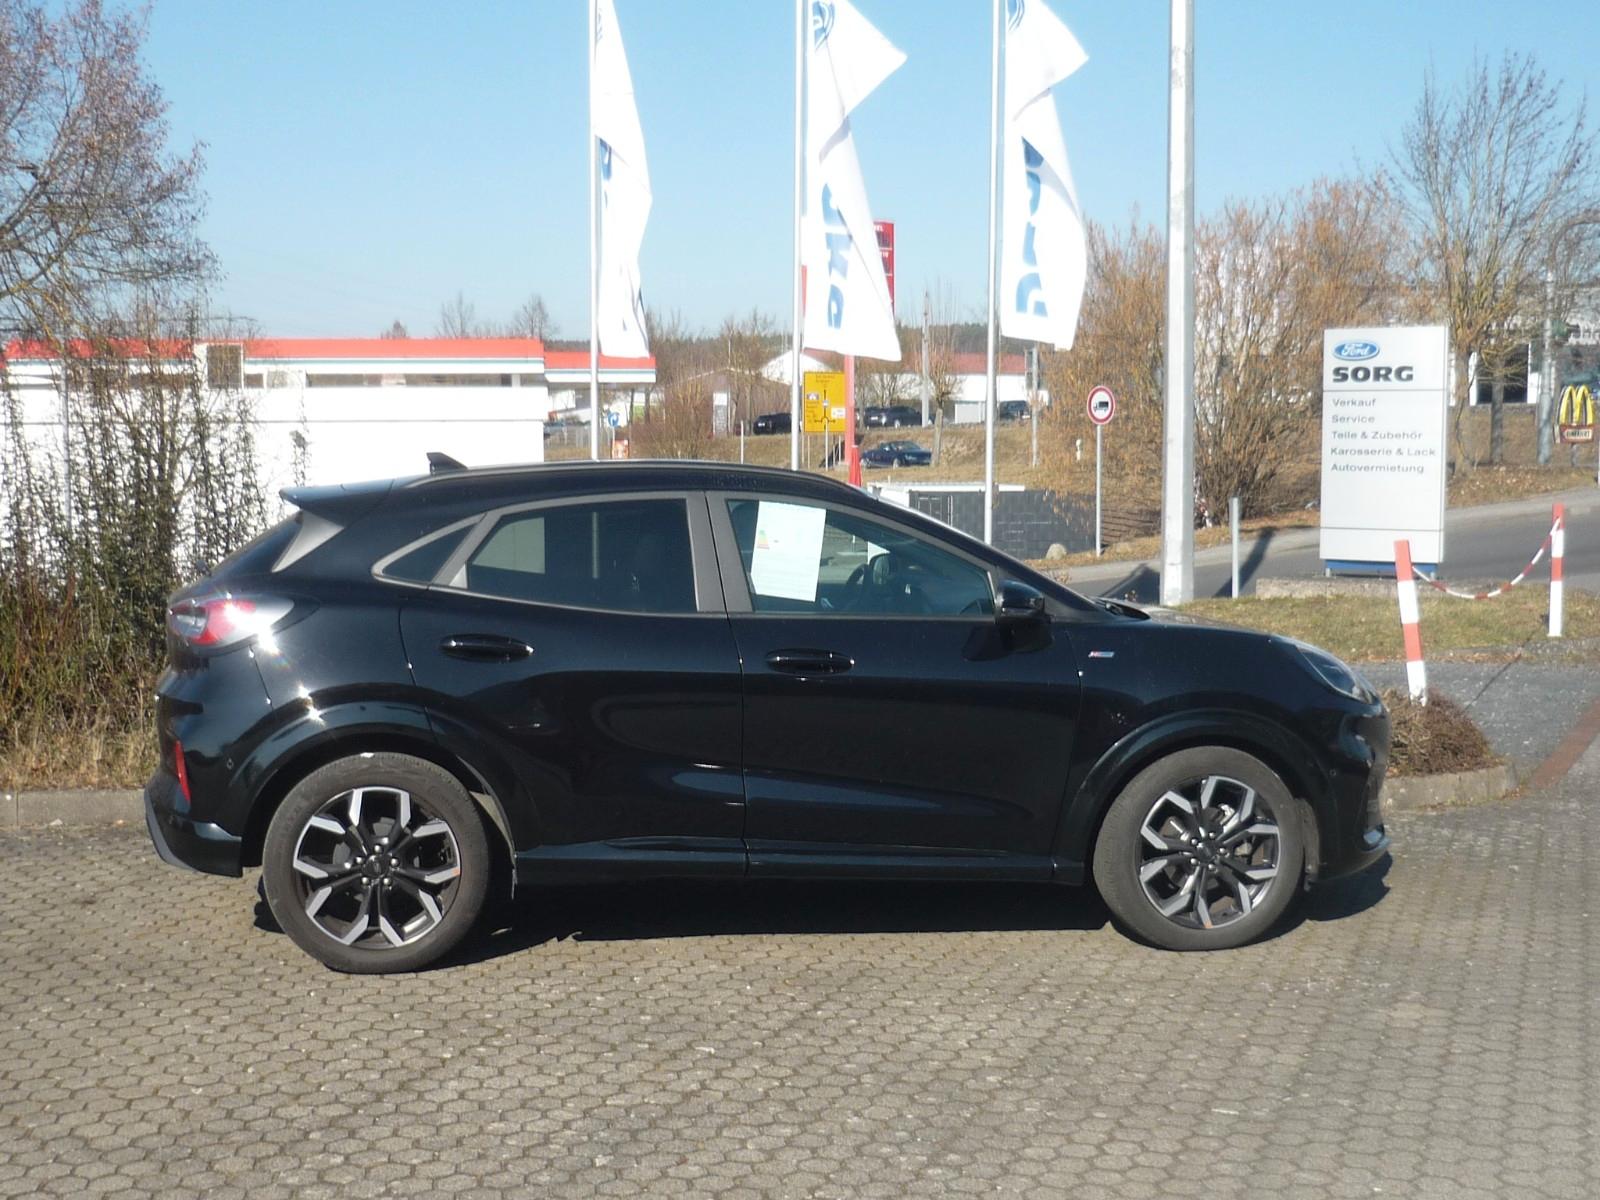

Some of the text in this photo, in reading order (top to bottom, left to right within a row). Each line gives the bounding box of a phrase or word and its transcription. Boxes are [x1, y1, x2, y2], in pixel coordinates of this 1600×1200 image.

[1340, 343, 1371, 356] Ford
[1332, 366, 1414, 383] SORG
[1331, 398, 1376, 408] Verkauf
[1331, 414, 1376, 424] Service
[1331, 430, 1423, 440] Teile & Zubehör
[1330, 447, 1437, 457] Karosserie & Lack
[1330, 463, 1425, 474] Autovermietung
